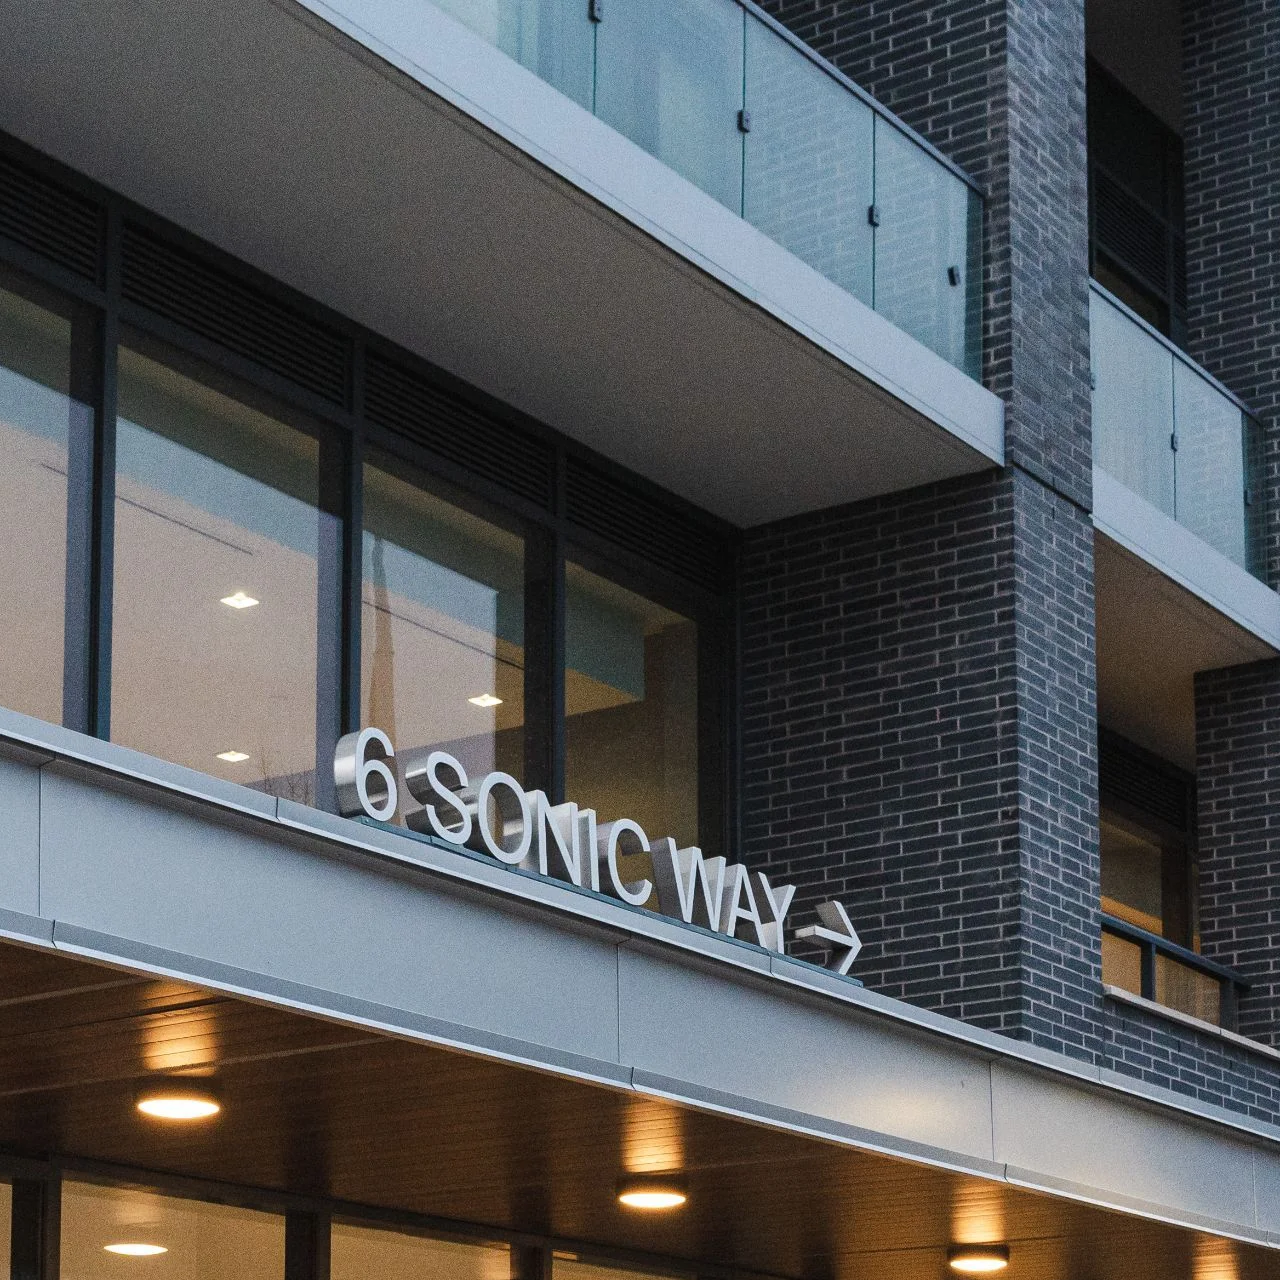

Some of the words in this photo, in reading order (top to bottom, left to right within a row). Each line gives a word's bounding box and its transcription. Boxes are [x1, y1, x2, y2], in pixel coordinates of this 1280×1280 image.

[348, 726, 398, 822] 6
[418, 750, 653, 906] SONIC
[664, 836, 797, 955] WAY
